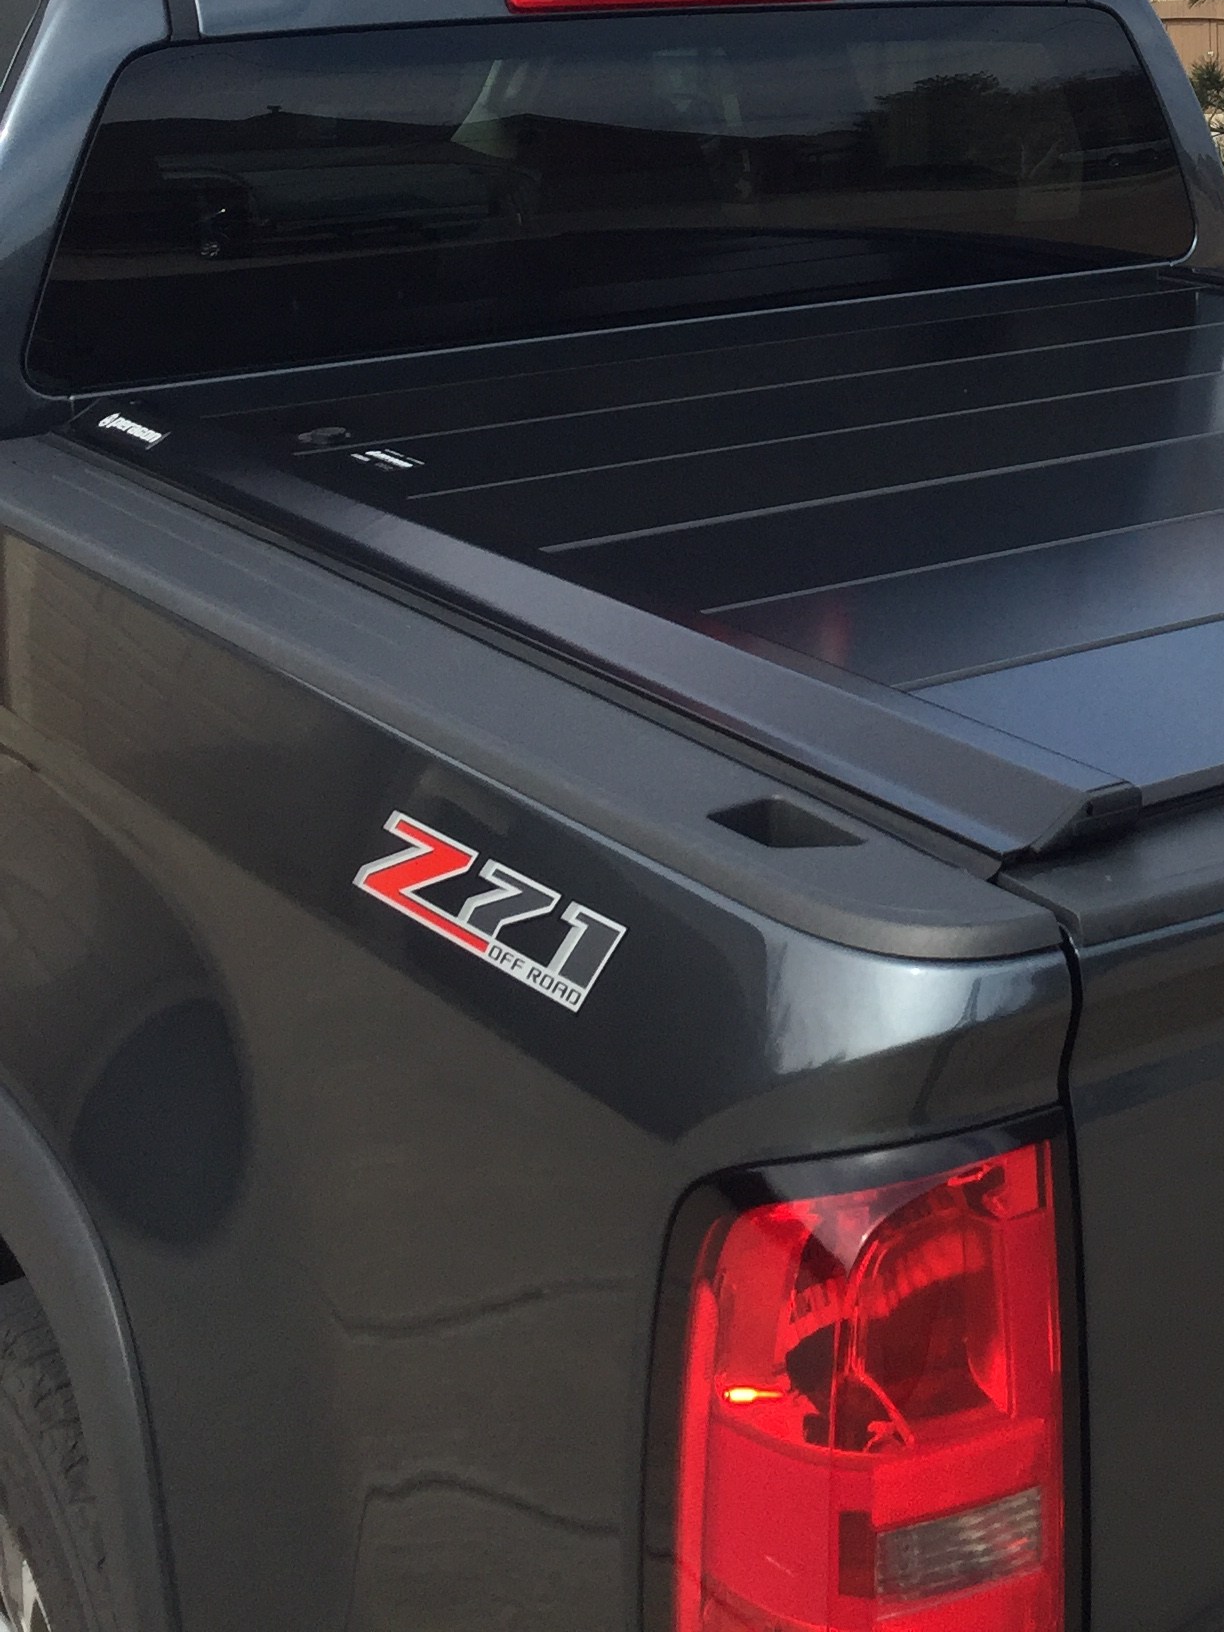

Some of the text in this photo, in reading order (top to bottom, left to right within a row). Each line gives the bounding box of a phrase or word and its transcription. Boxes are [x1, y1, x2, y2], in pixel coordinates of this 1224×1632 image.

[352, 809, 628, 991] Z71
[487, 944, 582, 1006] OFF ROAD
